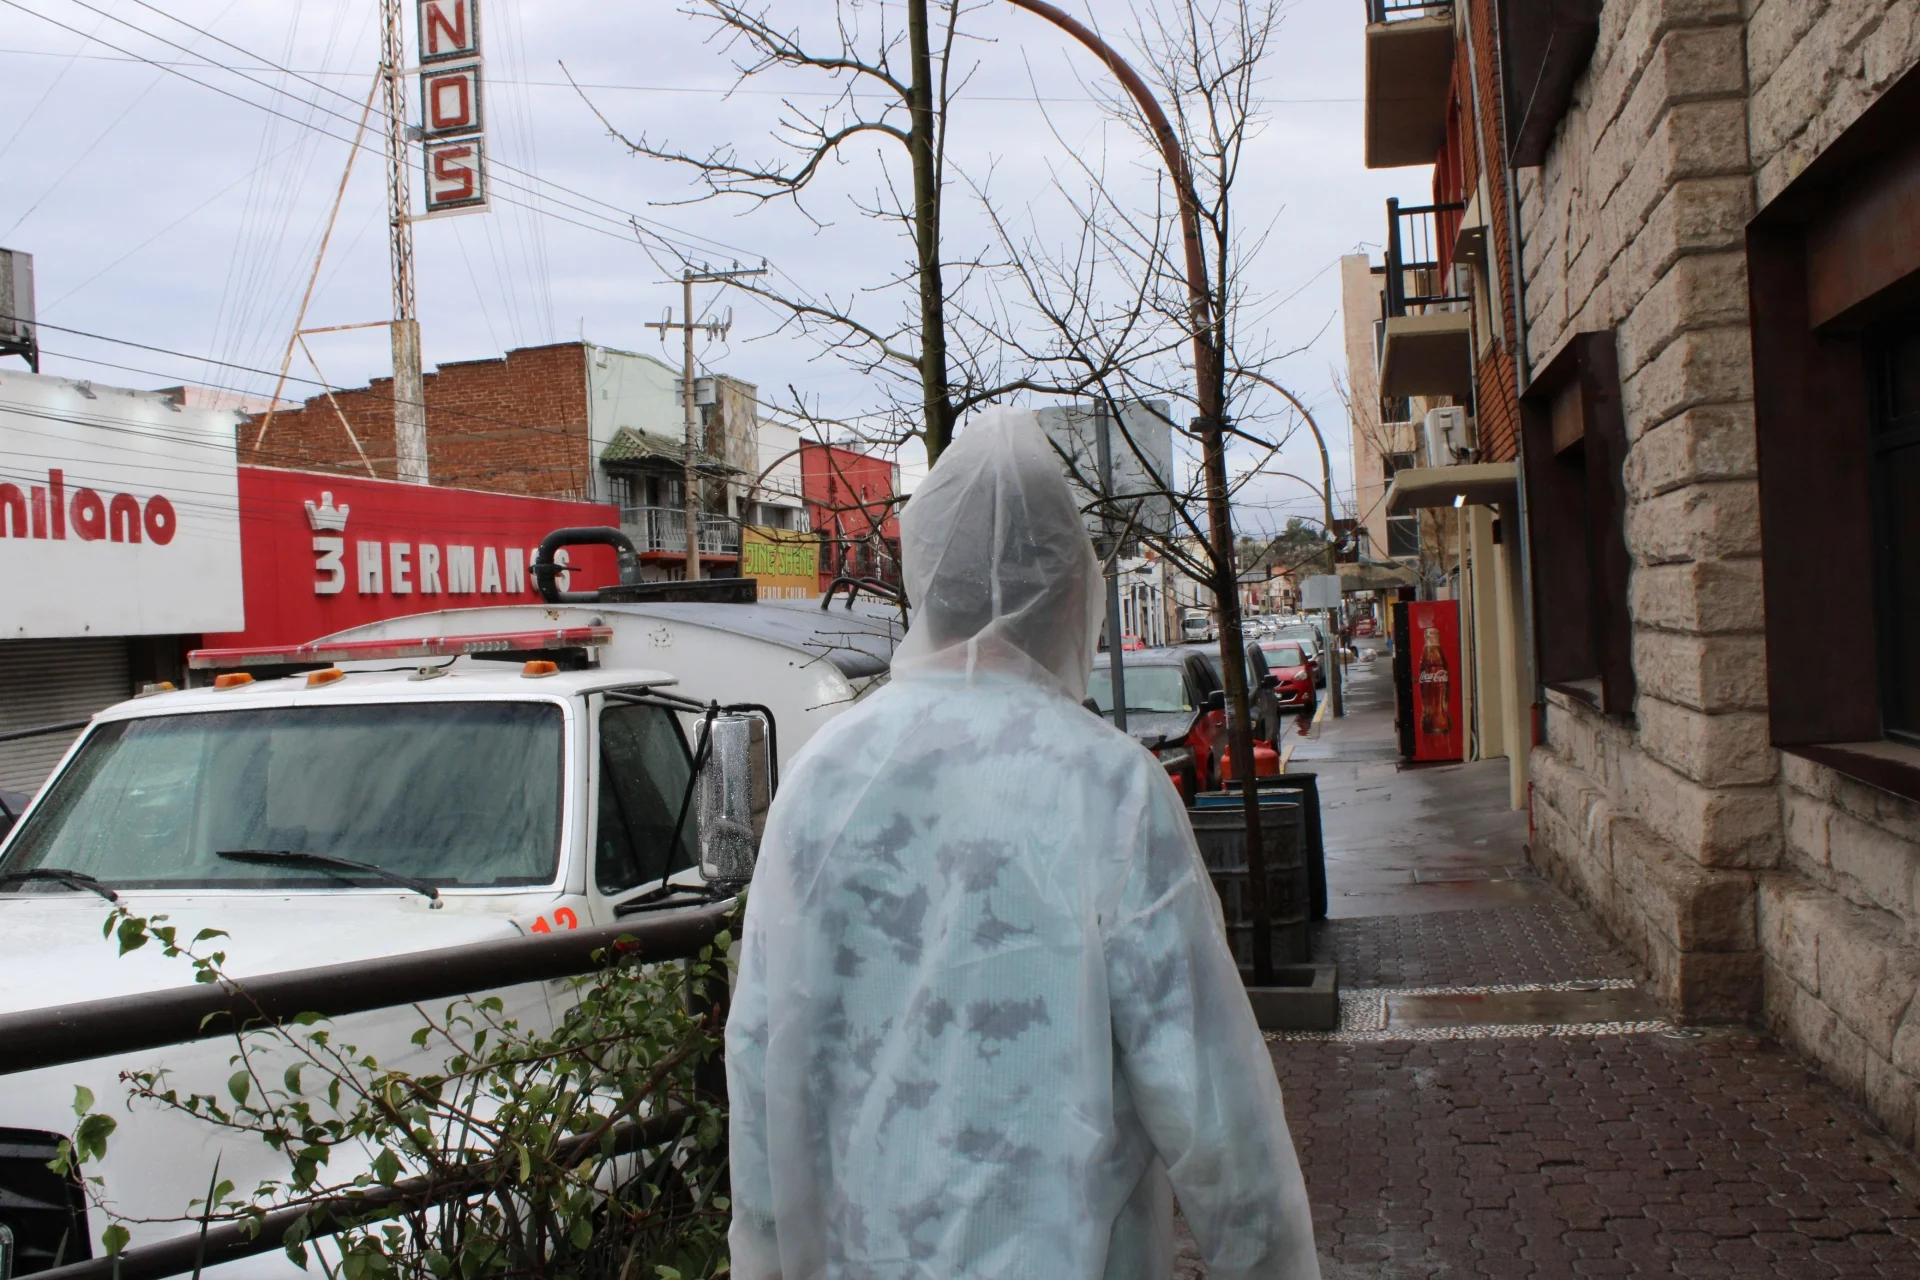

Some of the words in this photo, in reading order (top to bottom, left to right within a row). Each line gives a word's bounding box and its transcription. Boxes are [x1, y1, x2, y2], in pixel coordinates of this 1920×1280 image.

[312, 536, 346, 594] 3
[778, 544, 815, 580] SHENG
[756, 586, 782, 600] IENDA
[1419, 669, 1449, 684] Coca-Cola
